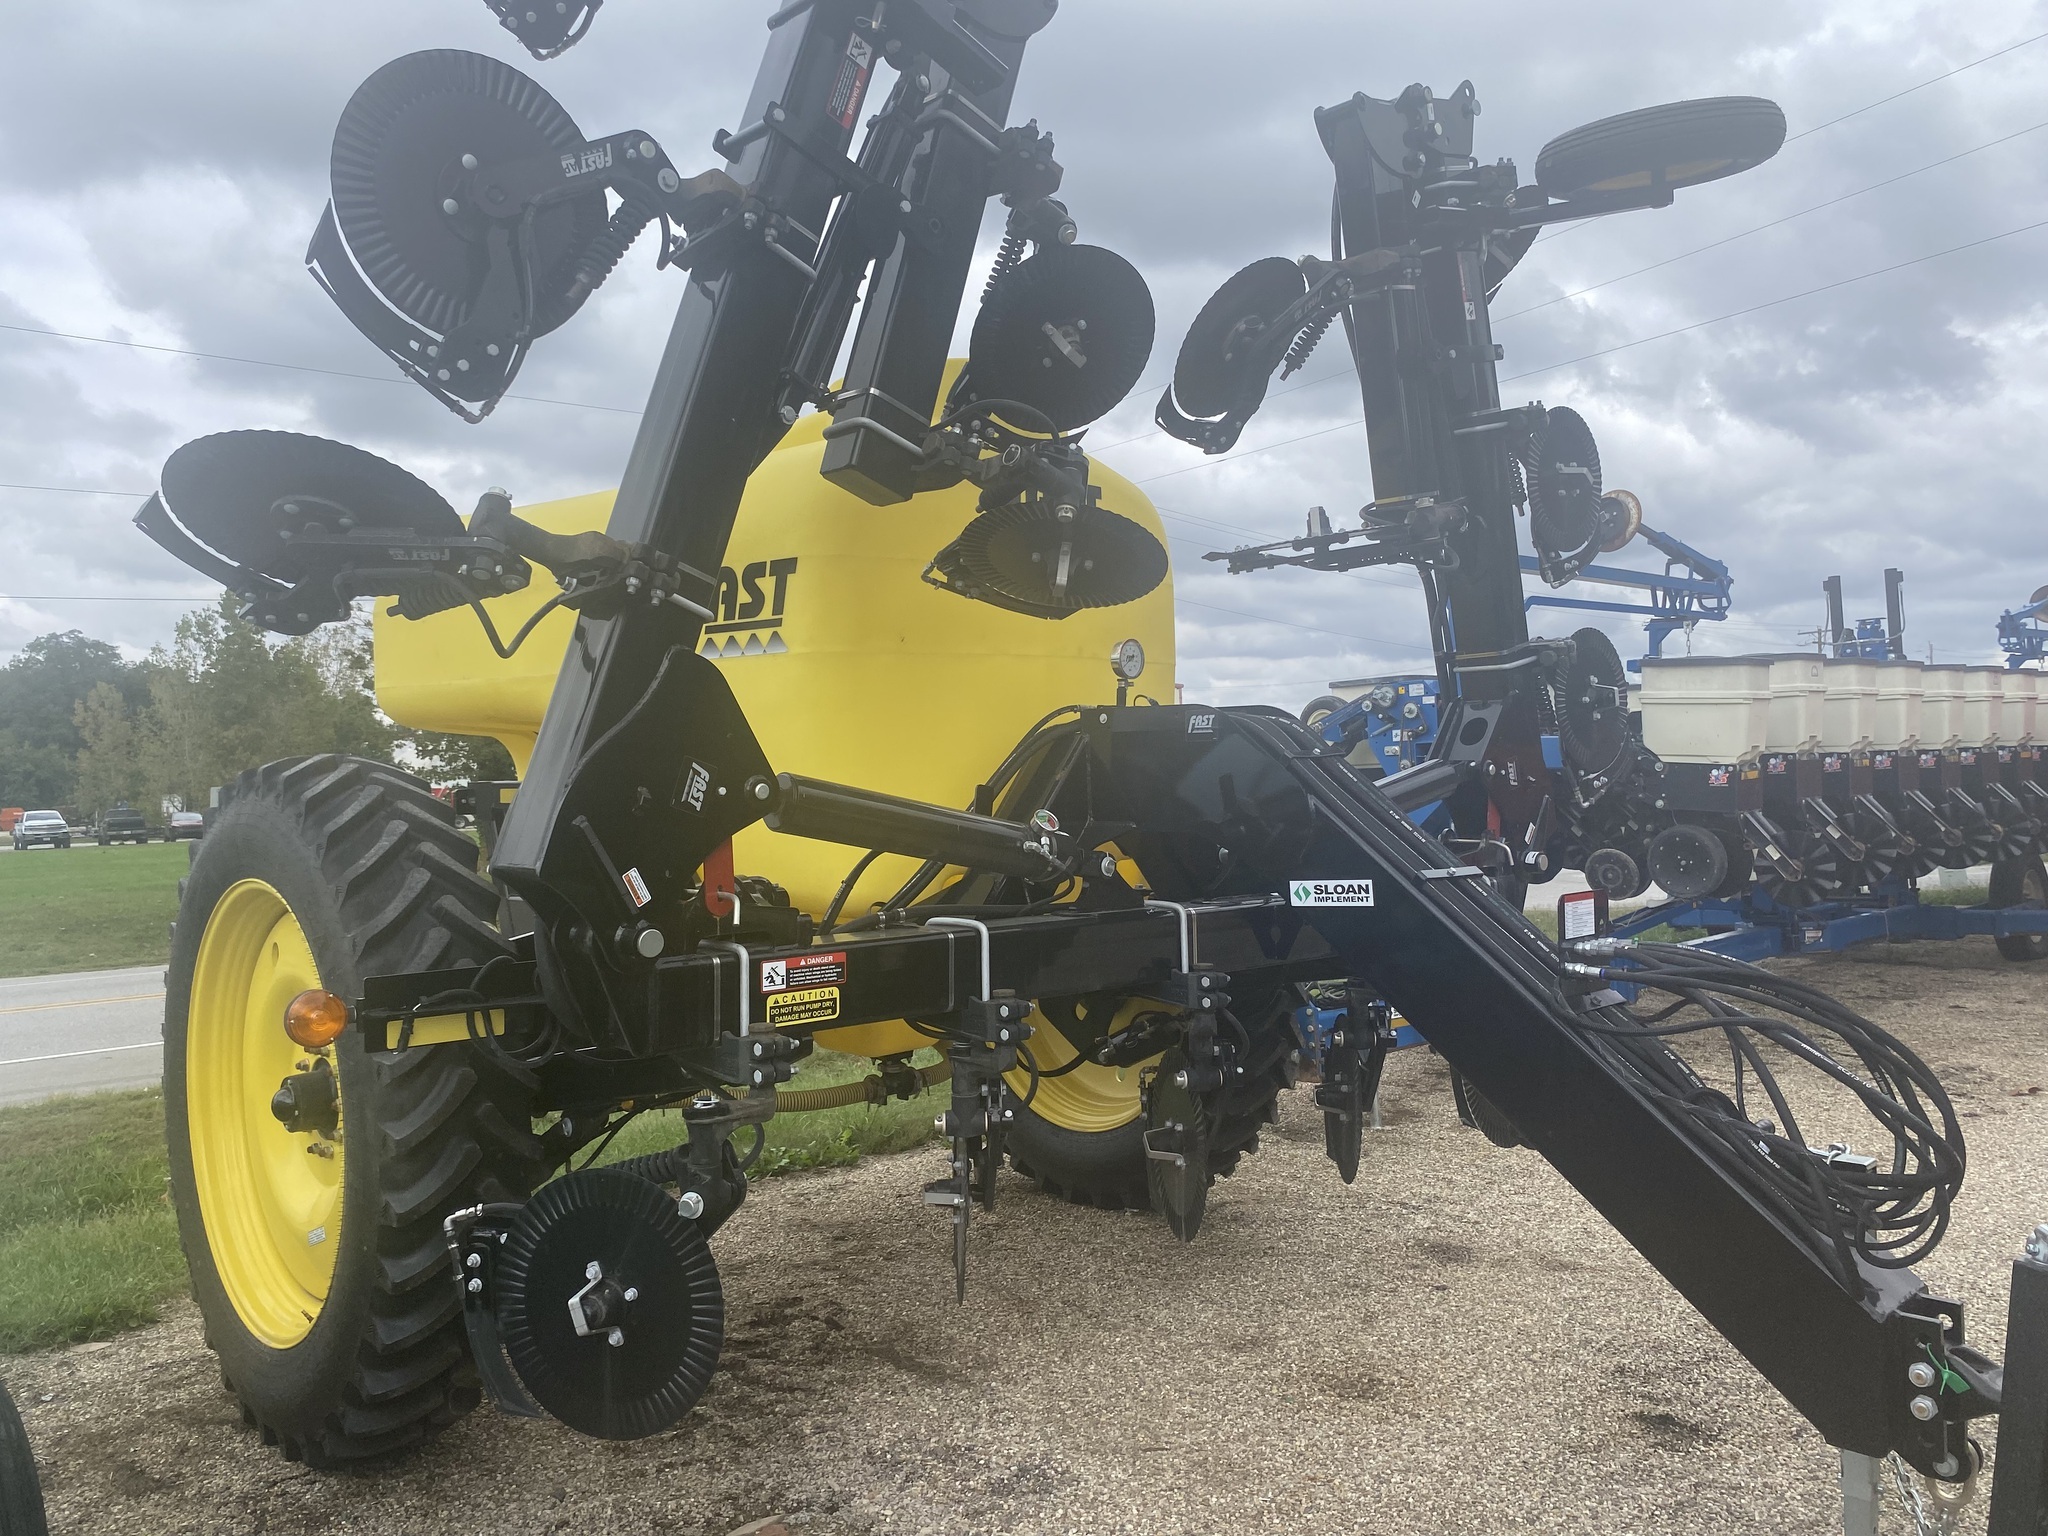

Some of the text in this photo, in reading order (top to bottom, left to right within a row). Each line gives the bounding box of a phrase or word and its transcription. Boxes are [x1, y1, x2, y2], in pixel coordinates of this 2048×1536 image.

[846, 88, 861, 115] DANGER
[581, 143, 613, 174] FAST
[709, 557, 798, 622] AST
[1188, 714, 1215, 733] FAST
[1507, 761, 1518, 785] FAST
[690, 762, 710, 811] FAST
[1313, 884, 1370, 895] SLOAN
[807, 955, 834, 965] DANGER
[782, 989, 834, 1004] CAUTION
[774, 1008, 833, 1022] DAMAGE MAY OCCUR
[793, 1004, 805, 1012] RUN
[806, 1002, 821, 1010] PUMP
